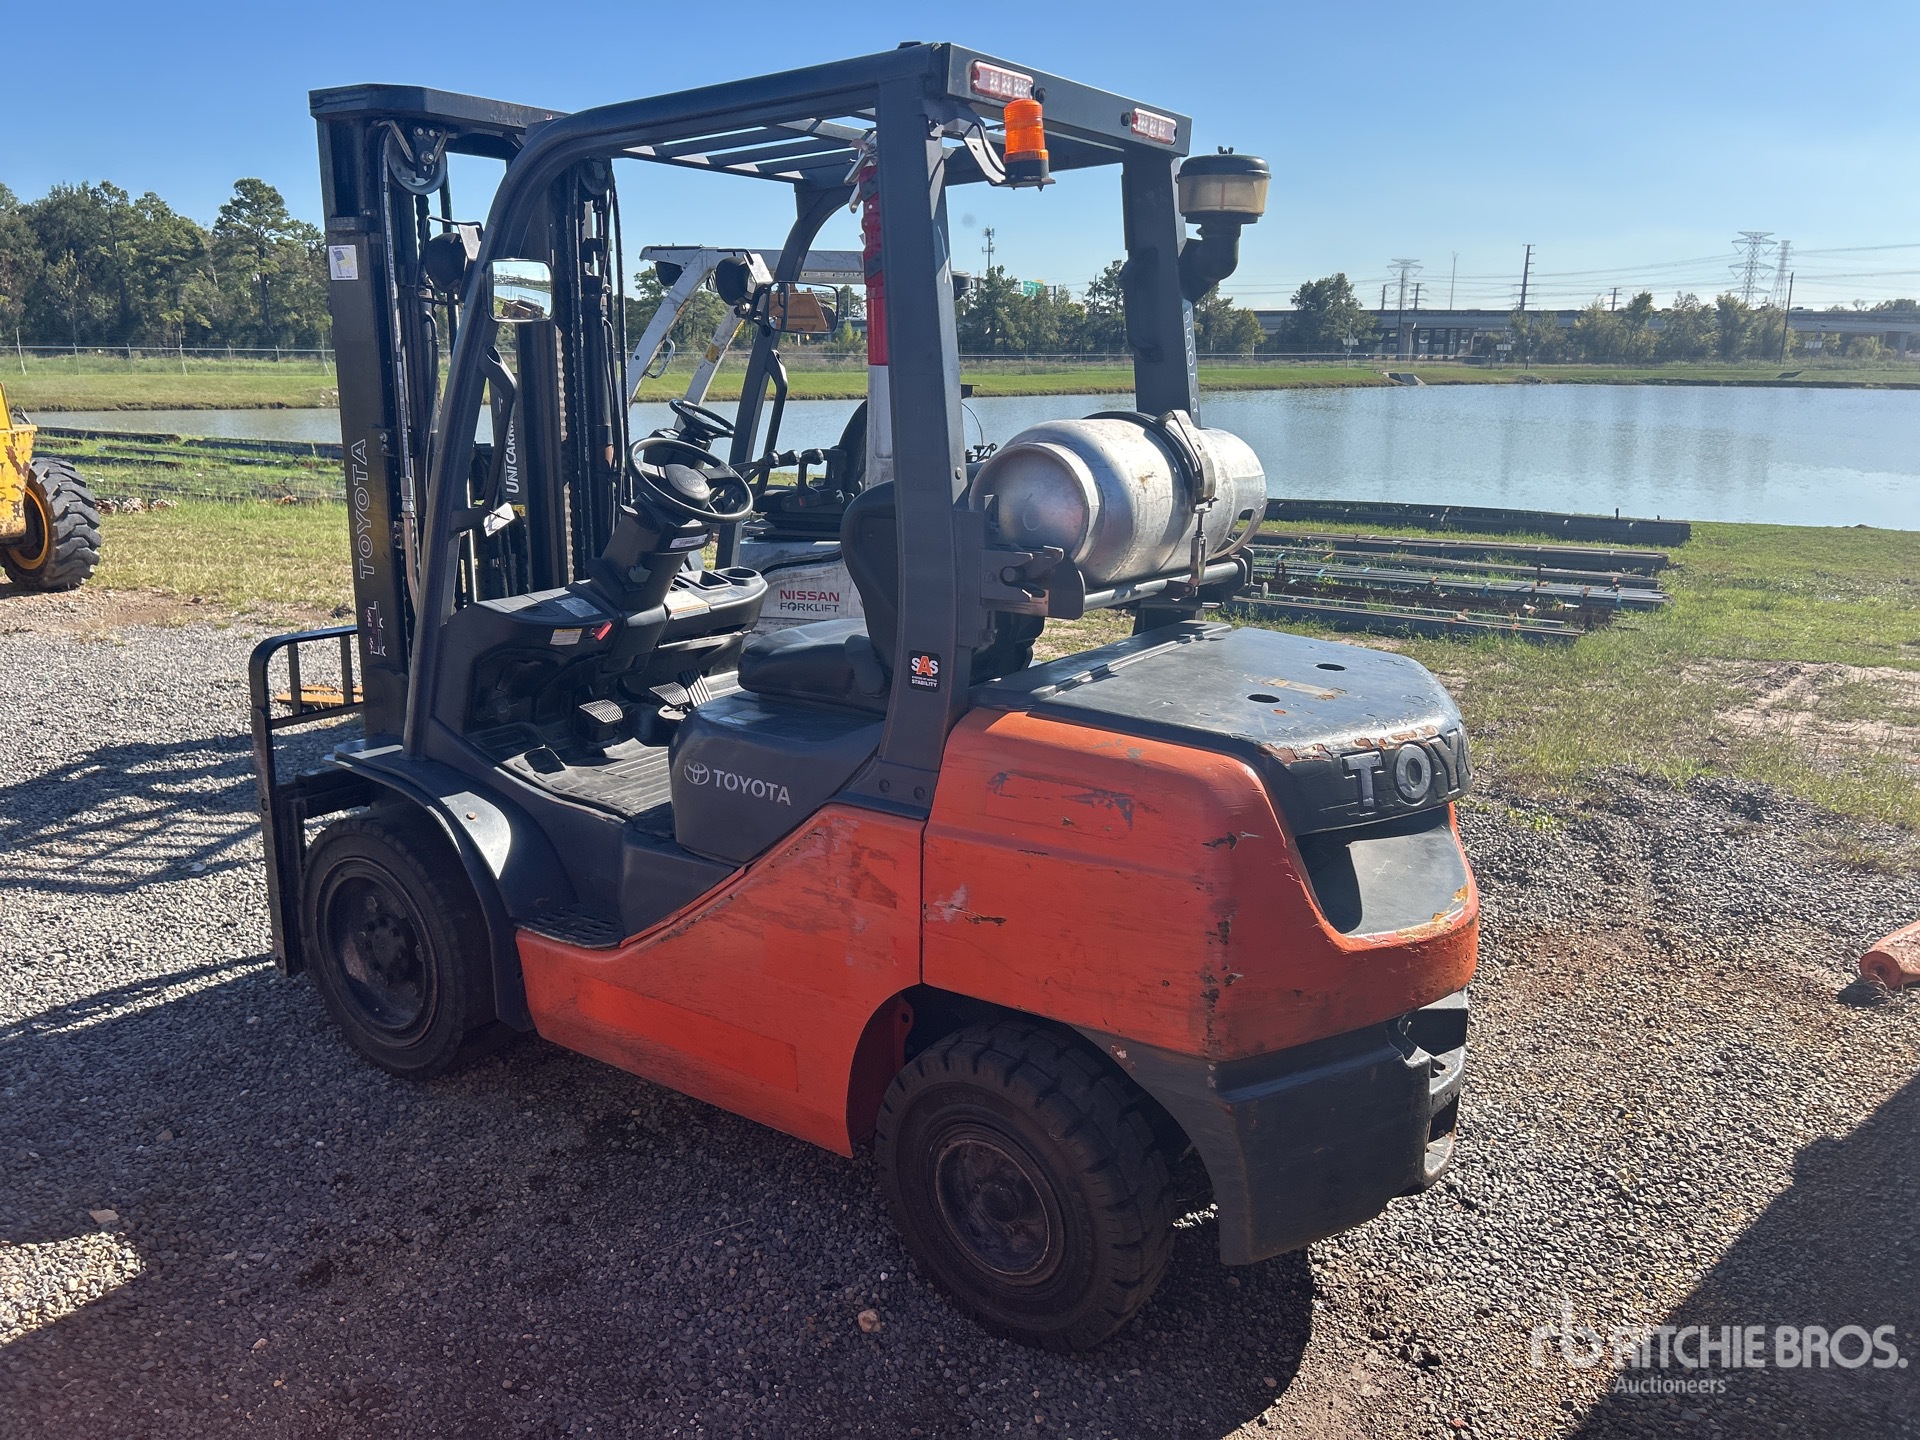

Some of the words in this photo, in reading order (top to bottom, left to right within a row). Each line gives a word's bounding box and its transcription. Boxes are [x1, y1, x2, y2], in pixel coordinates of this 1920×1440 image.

[505, 420, 520, 494] UNICAR
[351, 438, 375, 580] TOYOTA
[780, 590, 840, 602] NISSAN
[780, 602, 840, 612] FORKLIFT
[911, 656, 939, 677] SAS
[911, 679, 938, 687] STABILITY
[1341, 728, 1468, 815] TOY
[713, 769, 791, 806] TOYOTA
